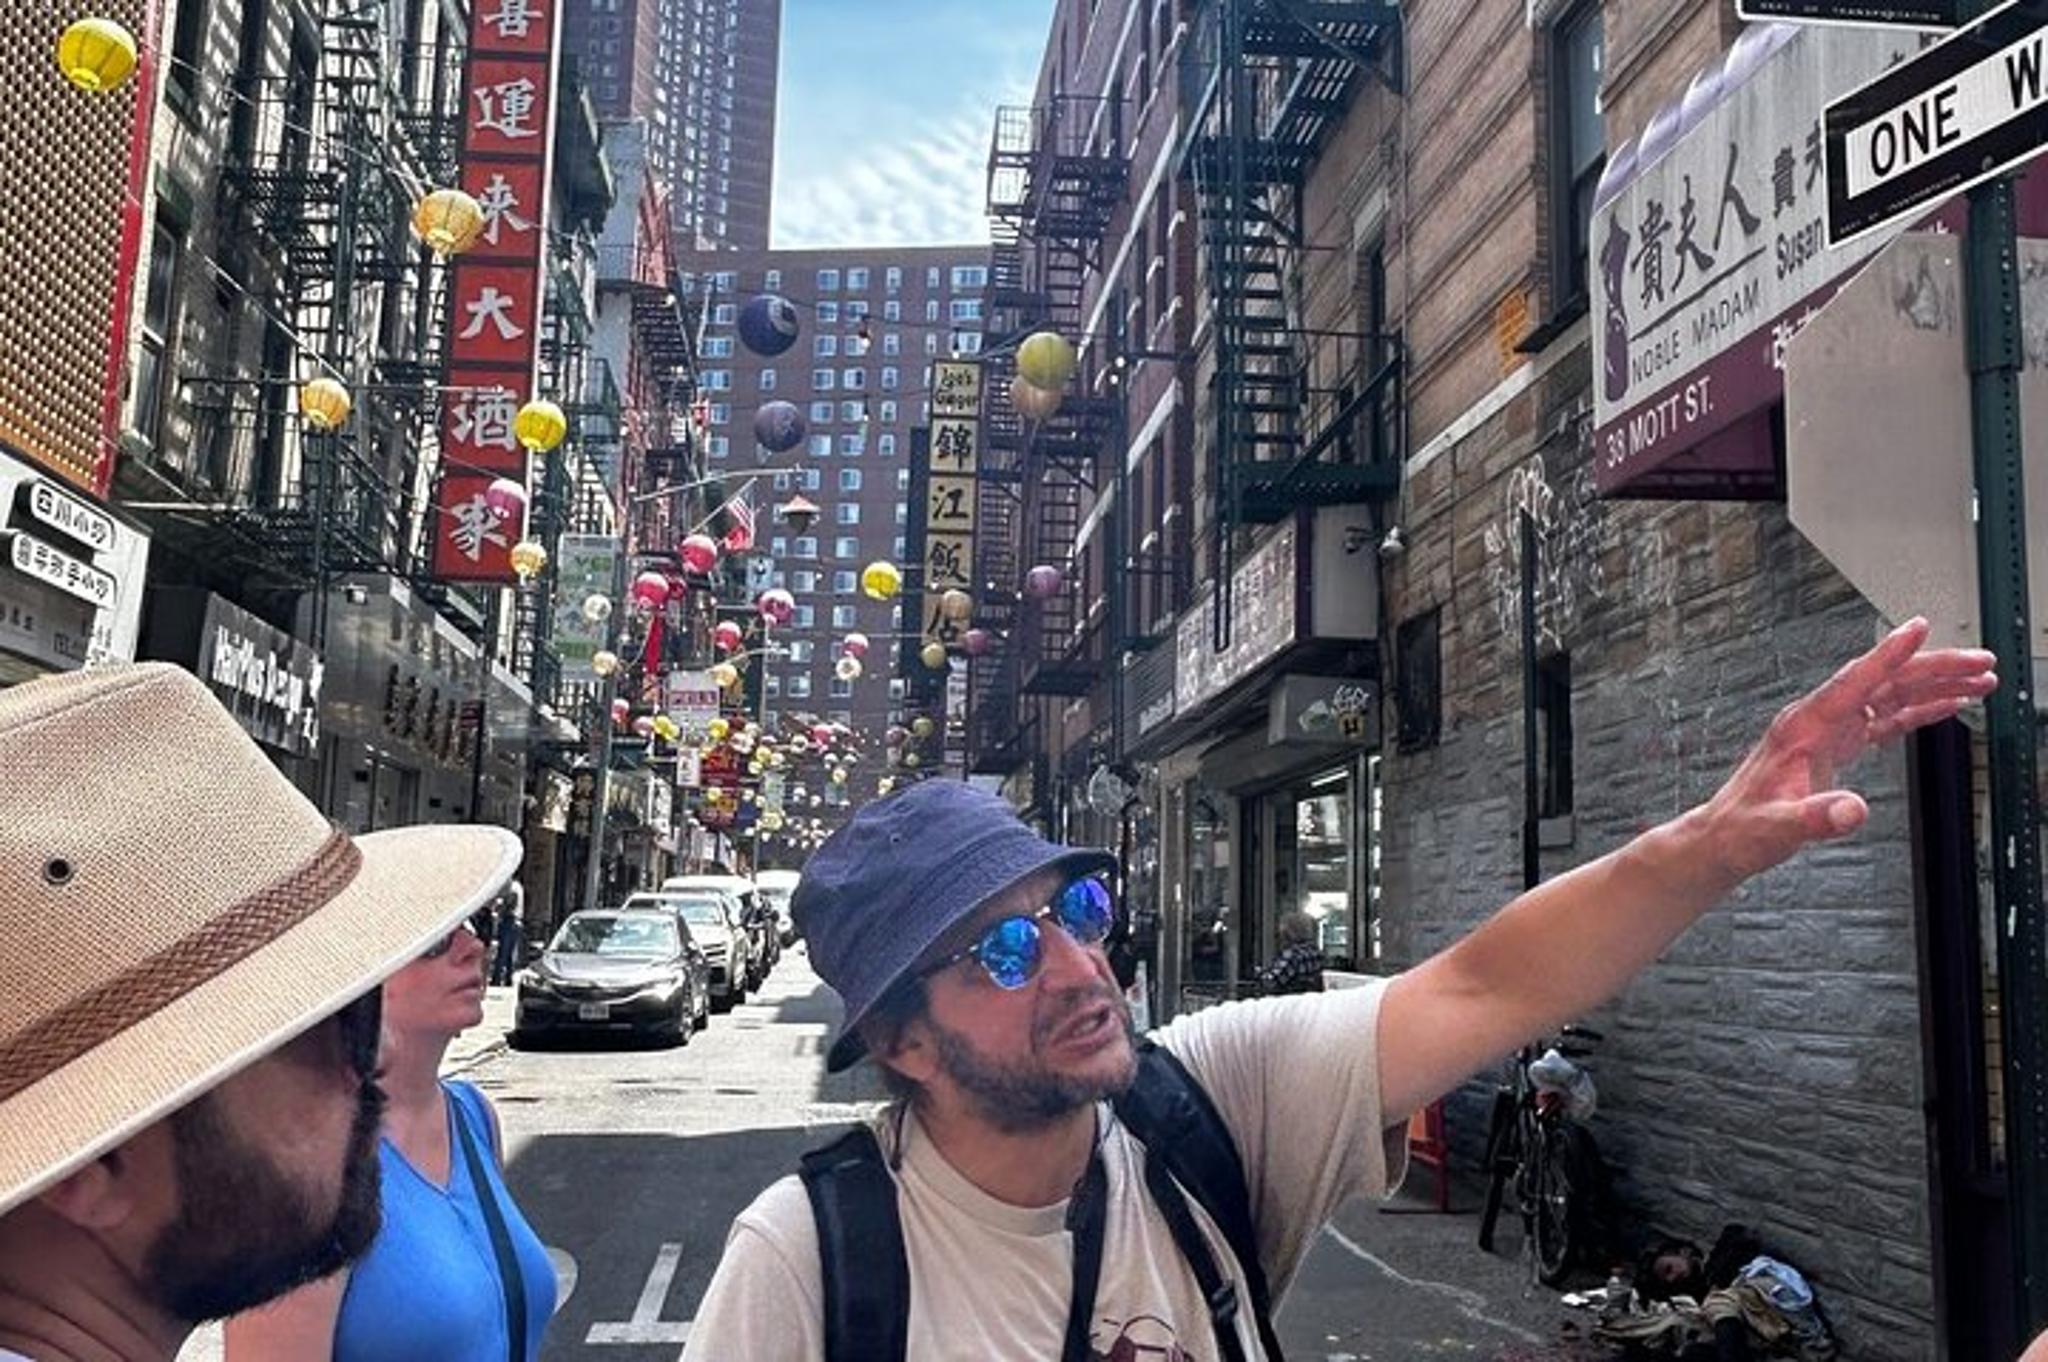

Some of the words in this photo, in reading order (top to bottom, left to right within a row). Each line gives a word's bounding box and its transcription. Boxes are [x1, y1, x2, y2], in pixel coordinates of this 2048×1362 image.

[1871, 84, 1961, 178] ONE
[2006, 38, 2048, 109] W
[1630, 143, 1761, 310] 貴夫人
[1777, 216, 1824, 280] Susan
[1632, 329, 1681, 385] NOBLE
[1692, 277, 1759, 346] MADAM
[1606, 427, 1627, 468] 38
[1628, 393, 1680, 456] MOTT
[1684, 374, 1714, 423] ST.
